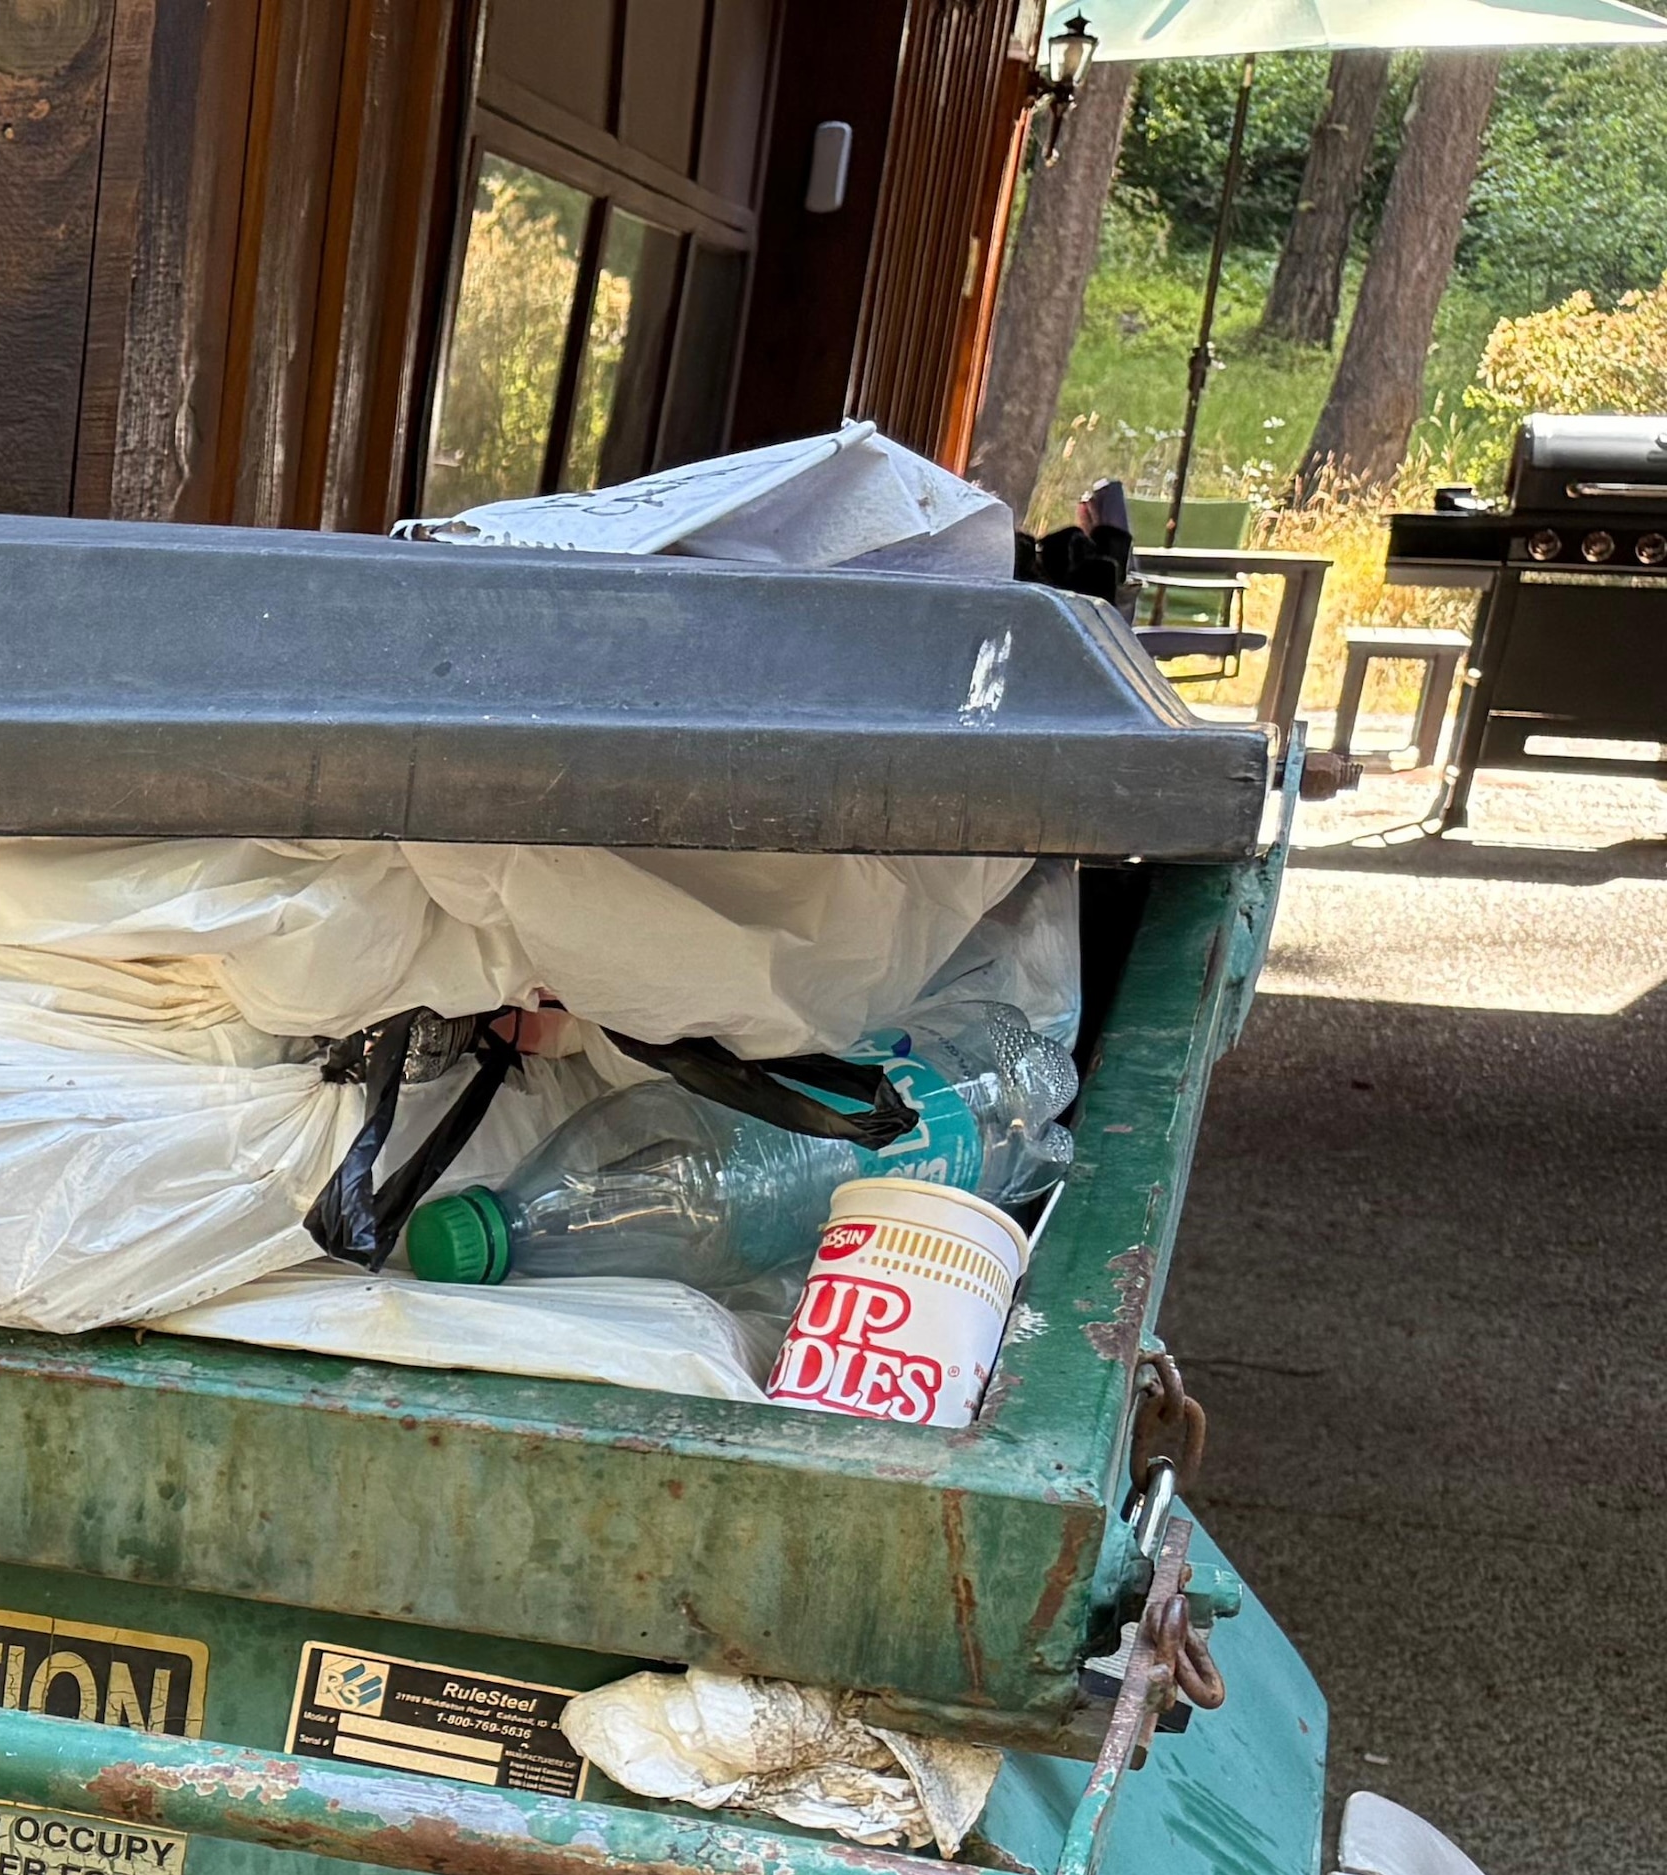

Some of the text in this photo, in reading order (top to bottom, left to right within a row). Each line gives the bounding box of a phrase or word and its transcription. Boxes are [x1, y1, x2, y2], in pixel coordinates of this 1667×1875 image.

[442, 1682, 538, 1713] RuleSteel
[304, 1711, 328, 1722] Model
[466, 1705, 490, 1717] Road
[436, 1712, 532, 1740] 1-800-769-5636
[299, 1733, 321, 1745] Serial
[14, 1816, 175, 1867] OCCUPY
